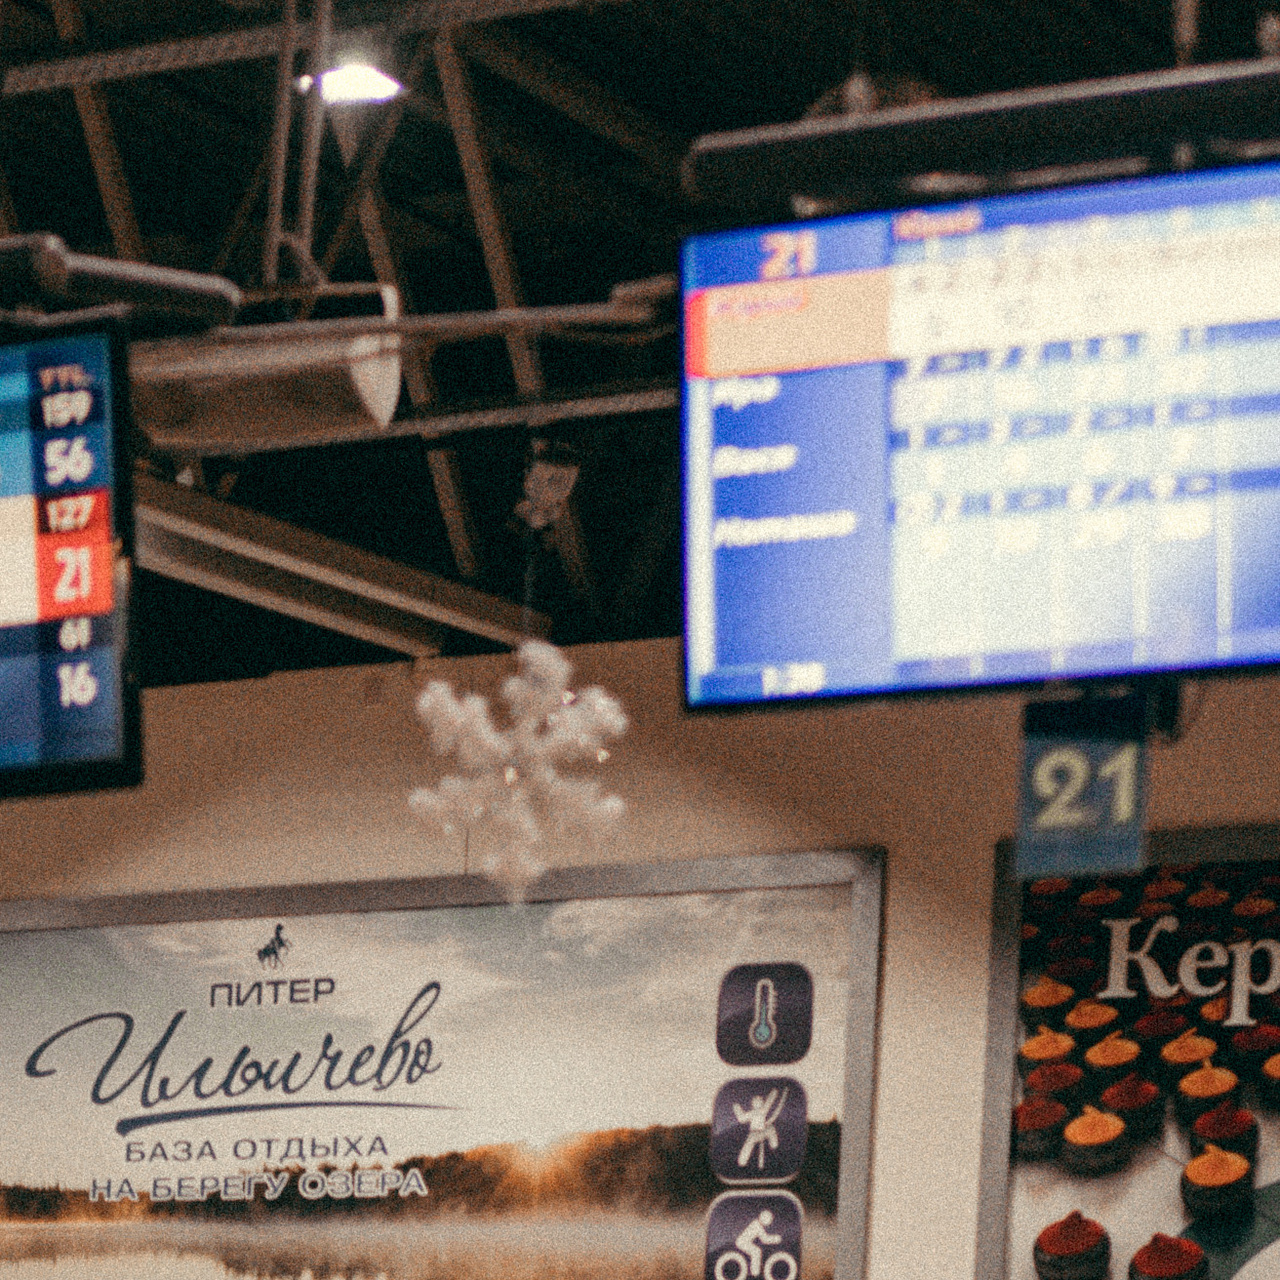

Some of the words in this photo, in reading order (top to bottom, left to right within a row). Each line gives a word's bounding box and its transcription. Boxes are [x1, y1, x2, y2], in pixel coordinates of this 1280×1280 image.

[761, 231, 817, 278] 21
[44, 437, 93, 486] 56
[46, 495, 94, 528] 127
[53, 546, 92, 603] 21
[59, 617, 91, 650] 61
[58, 662, 98, 708] 16
[1032, 742, 1137, 826] 21
[210, 978, 335, 1008] ПИТЕР
[24, 981, 441, 1108] Ильичево
[125, 1139, 217, 1163] БАЗА
[232, 1136, 387, 1163] ОТДЫХА
[90, 1177, 138, 1202] НА
[150, 1171, 289, 1202] БЕРЕГУ
[299, 1167, 428, 1199] ОЗЕРА
